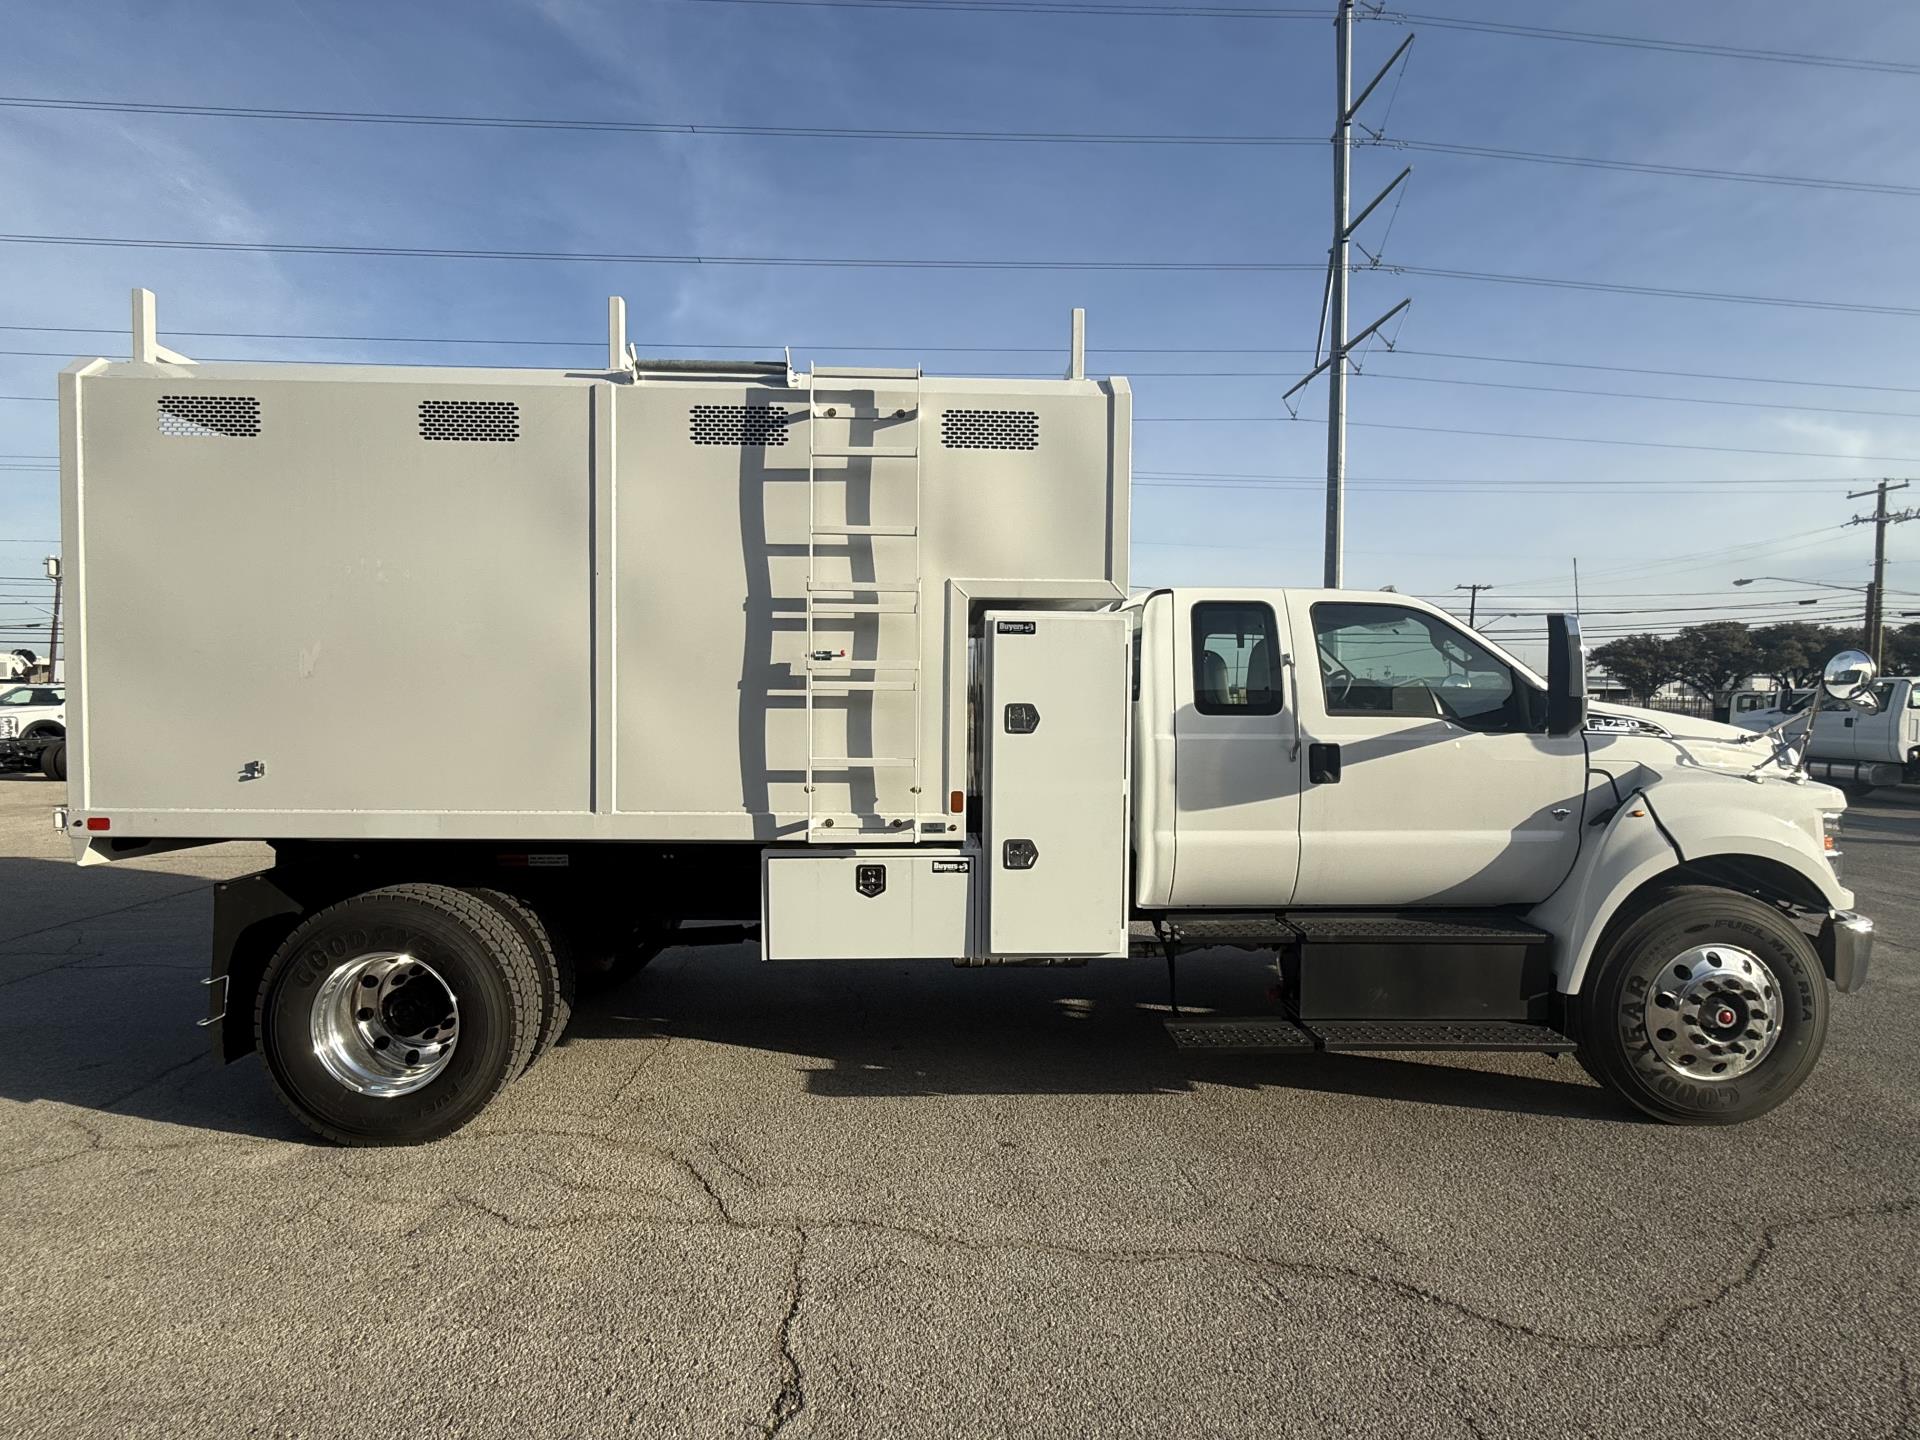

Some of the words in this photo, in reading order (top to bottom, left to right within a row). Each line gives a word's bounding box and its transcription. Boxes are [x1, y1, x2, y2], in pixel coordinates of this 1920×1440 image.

[999, 622, 1024, 631] Buyers
[933, 861, 958, 871] Buyers
[1713, 919, 1765, 938] FUEL
[1769, 939, 1804, 976] MAX
[1798, 981, 1813, 1021] RSA
